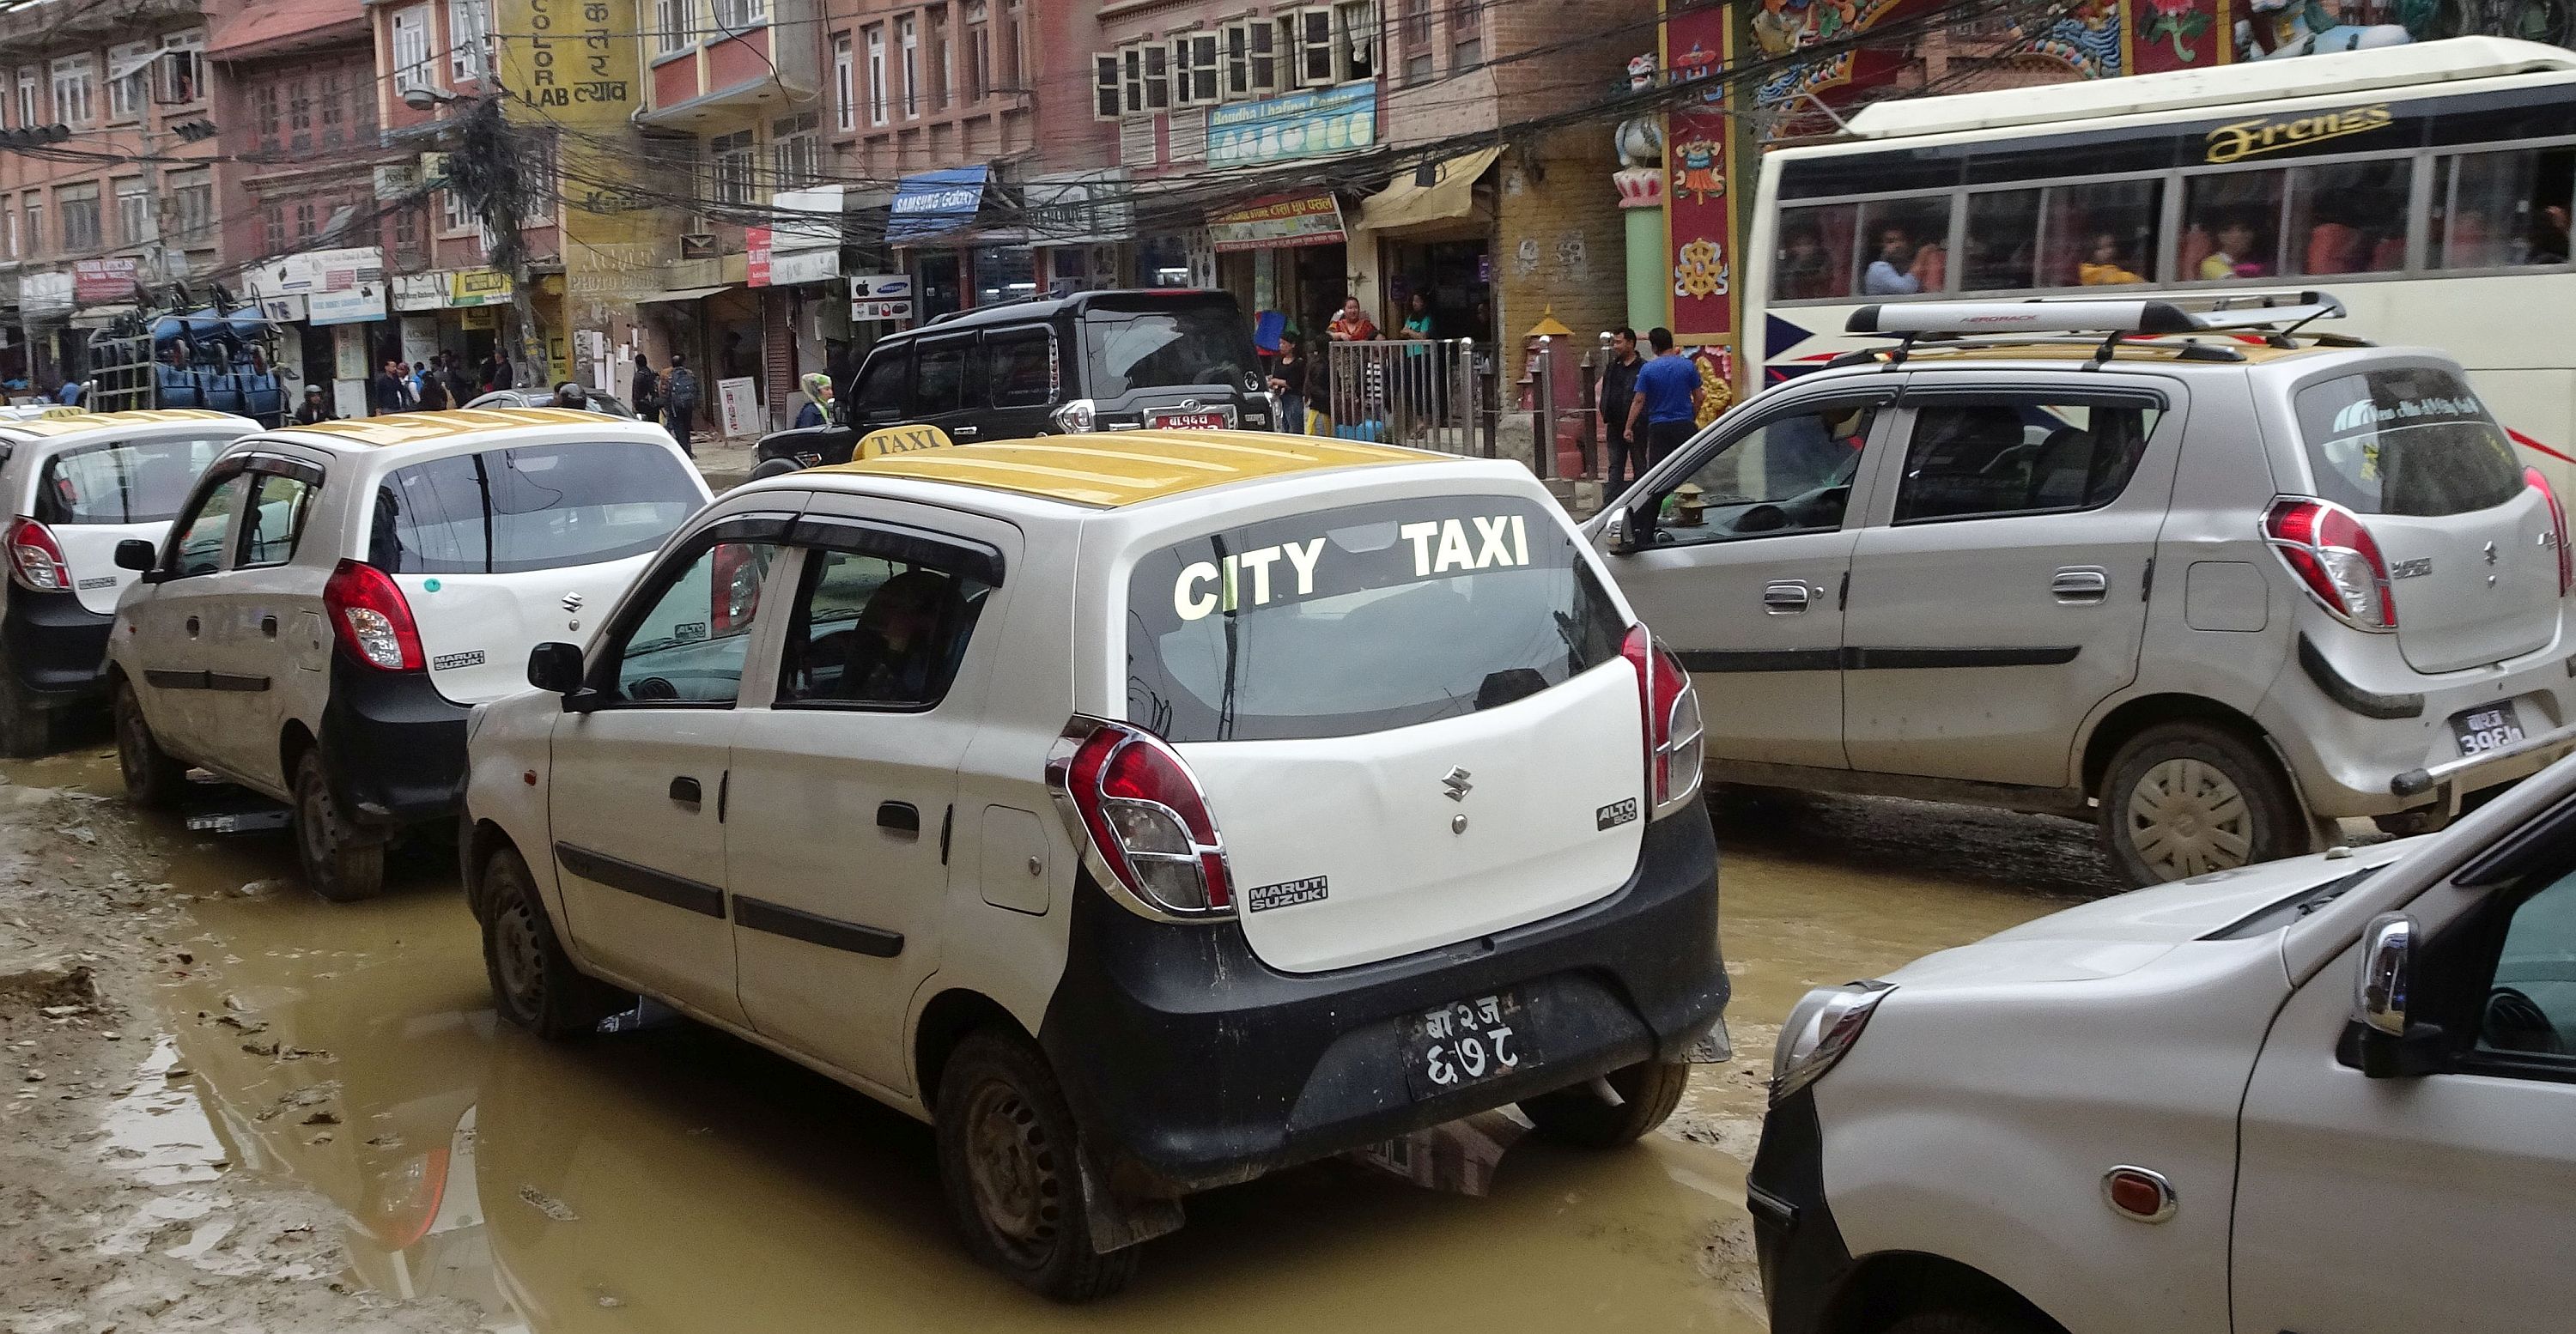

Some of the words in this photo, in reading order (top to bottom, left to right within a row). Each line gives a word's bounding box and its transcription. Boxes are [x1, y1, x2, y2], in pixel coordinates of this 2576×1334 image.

[526, 88, 569, 107] LAB
[1213, 107, 1258, 126] Boudha
[896, 192, 940, 213] SAMSUNG
[941, 190, 975, 208] Galaxy
[872, 428, 941, 455] TAXI
[1173, 537, 1327, 622] CITY
[1400, 515, 1530, 577] TAXI
[676, 623, 705, 634] ALTO
[434, 651, 483, 664] MARUTI
[435, 657, 484, 670] SUZUKI
[1598, 799, 1636, 822] ALTO
[1613, 811, 1637, 825] 800
[1250, 876, 1327, 900] MARUTI
[1251, 888, 1327, 910] SUZUKI
[1426, 1027, 1519, 1085] ६७८
